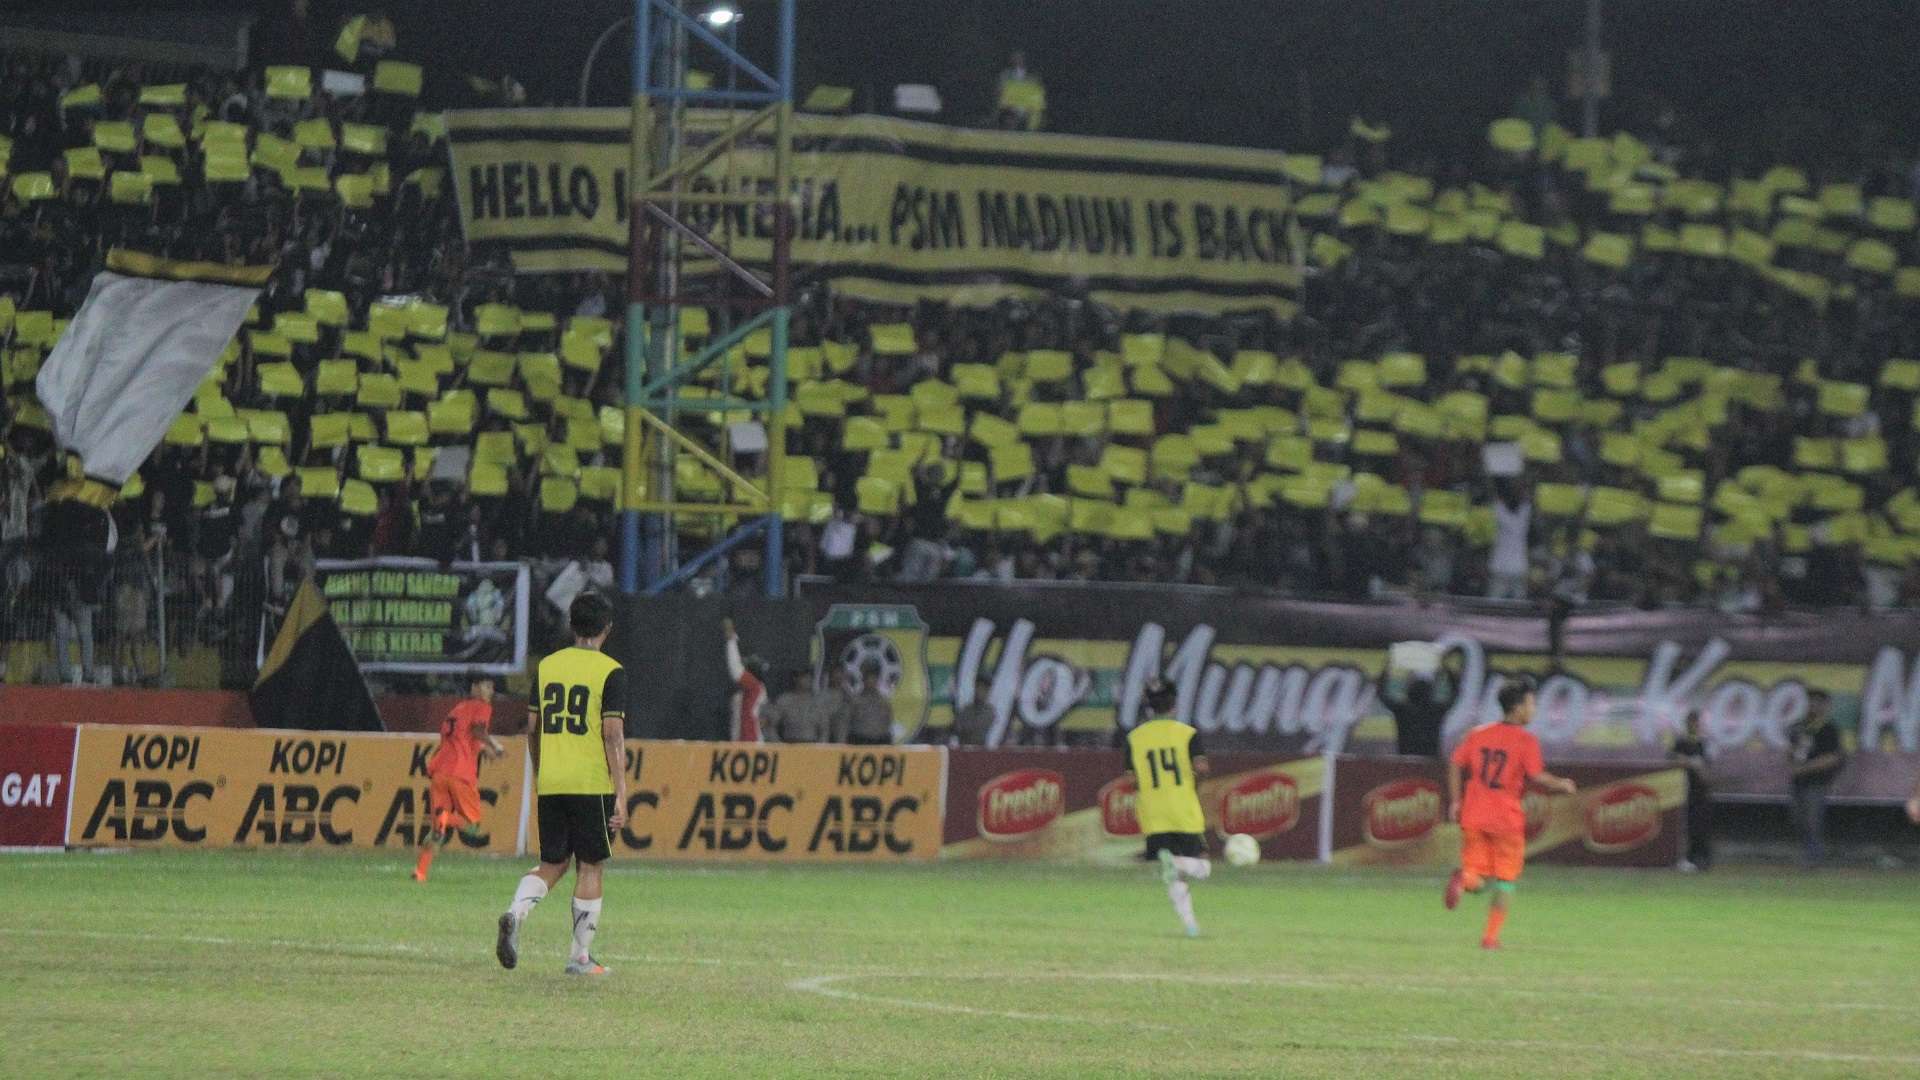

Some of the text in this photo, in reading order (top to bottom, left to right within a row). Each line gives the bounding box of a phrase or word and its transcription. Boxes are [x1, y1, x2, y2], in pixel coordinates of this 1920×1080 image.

[469, 161, 599, 222] HELLO
[889, 181, 967, 250] PSM
[977, 188, 1137, 257] MADIUN
[1146, 200, 1184, 259] IS
[1194, 202, 1298, 264] BACK
[543, 682, 590, 735] 29
[957, 617, 1090, 750] Yo
[1119, 621, 1377, 754] Mung
[120, 733, 200, 770] KOPI
[270, 738, 347, 775] KOPI
[709, 751, 779, 783] KOPI
[838, 753, 906, 786] KOPI
[1147, 747, 1183, 788] 14
[1481, 747, 1508, 790] 12
[1, 772, 62, 808] GAT
[82, 779, 215, 842] ABC
[233, 782, 361, 845] ABC
[678, 791, 794, 851] ABC
[808, 794, 920, 855] ABC
